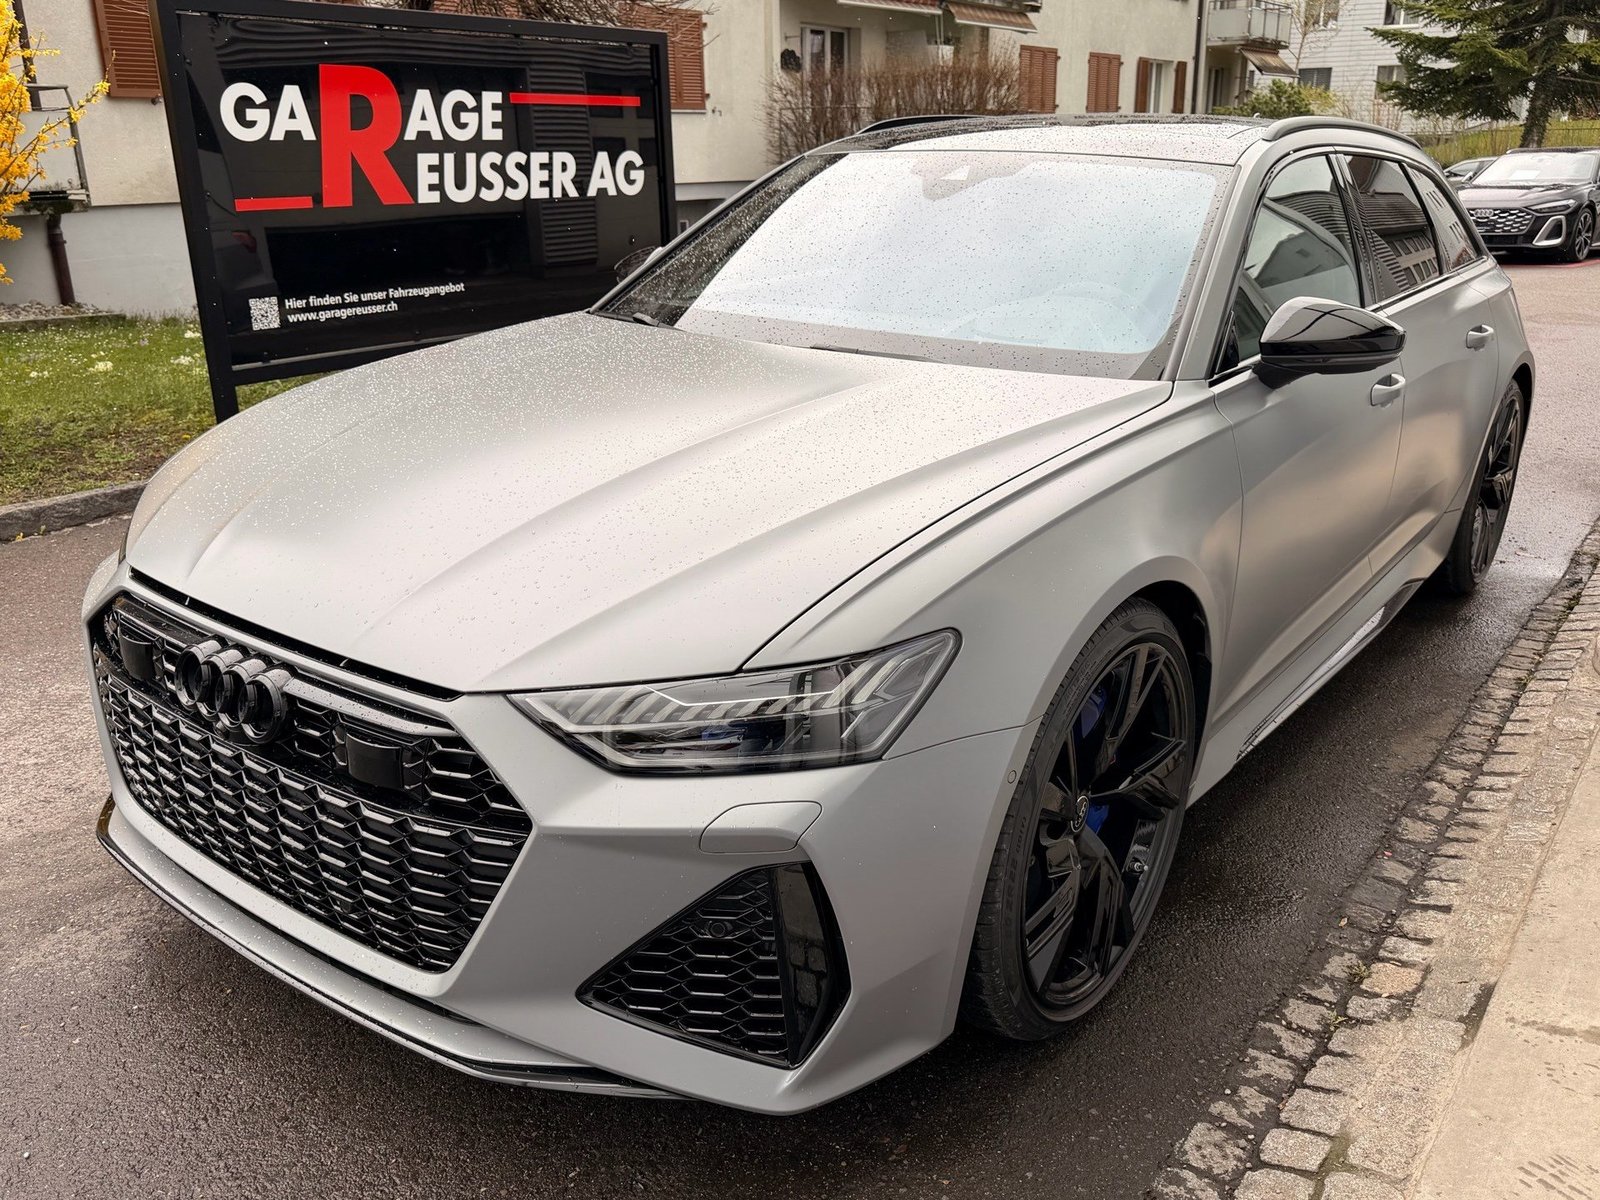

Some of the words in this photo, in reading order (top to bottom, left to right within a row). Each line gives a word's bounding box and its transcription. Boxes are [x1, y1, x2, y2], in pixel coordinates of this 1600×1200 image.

[219, 63, 503, 208] GARAGE
[586, 149, 646, 197] AG
[284, 297, 307, 310] Hier
[308, 294, 343, 307] finden
[344, 292, 359, 304] Sie
[360, 290, 388, 302] unser
[388, 282, 465, 298] Fahrzeugangebot
[287, 301, 398, 323] www.garagereusser.ch
